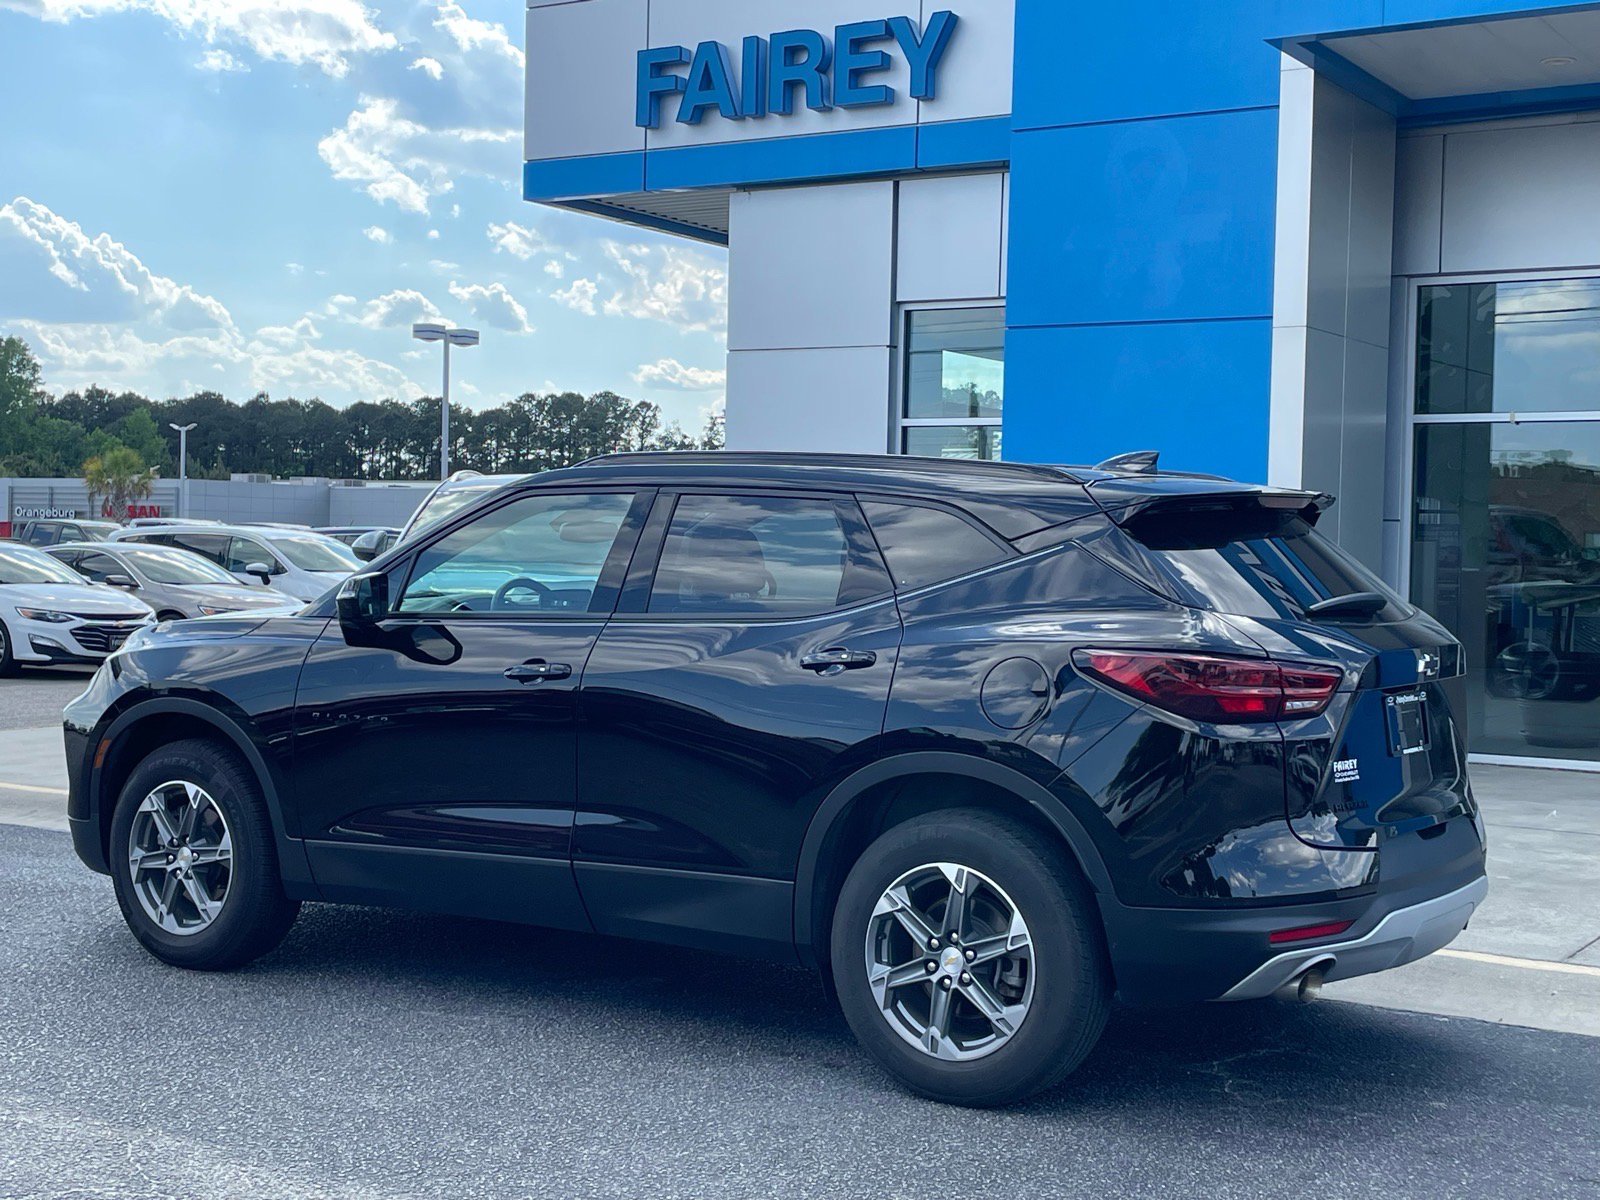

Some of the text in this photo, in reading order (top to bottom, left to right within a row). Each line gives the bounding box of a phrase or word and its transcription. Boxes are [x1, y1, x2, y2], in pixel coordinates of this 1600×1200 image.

[635, 10, 958, 129] FAIREY
[14, 505, 76, 519] Orangeburg
[101, 505, 161, 519] NSAN
[1333, 758, 1358, 773] FAIREY
